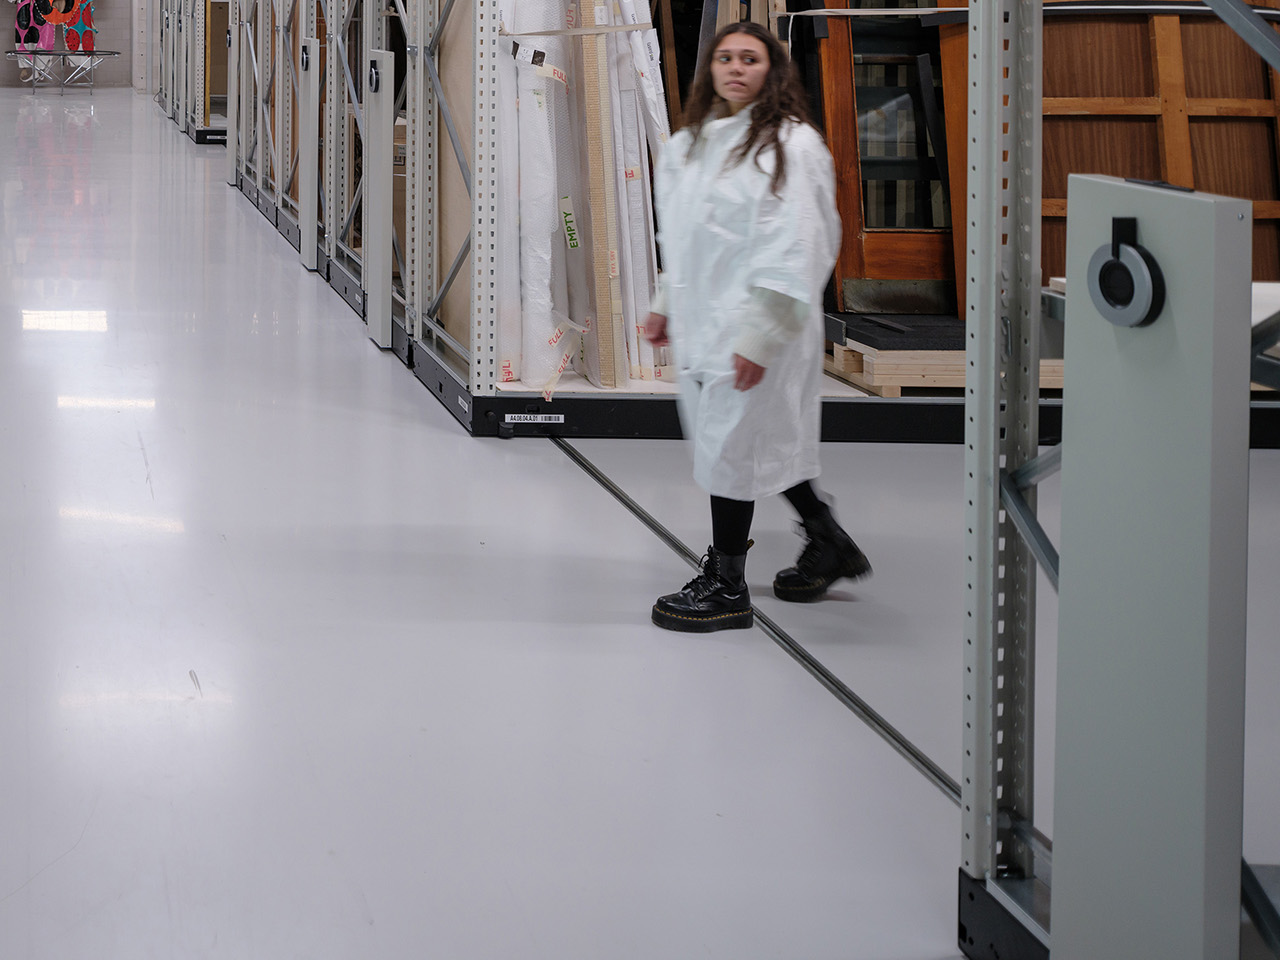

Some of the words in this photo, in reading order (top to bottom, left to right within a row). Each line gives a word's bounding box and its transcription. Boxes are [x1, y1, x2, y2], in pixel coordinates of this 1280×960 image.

[552, 68, 568, 84] FULL
[562, 211, 579, 249] EMPTY
[547, 327, 564, 347] FULL
[557, 352, 571, 374] FULL
